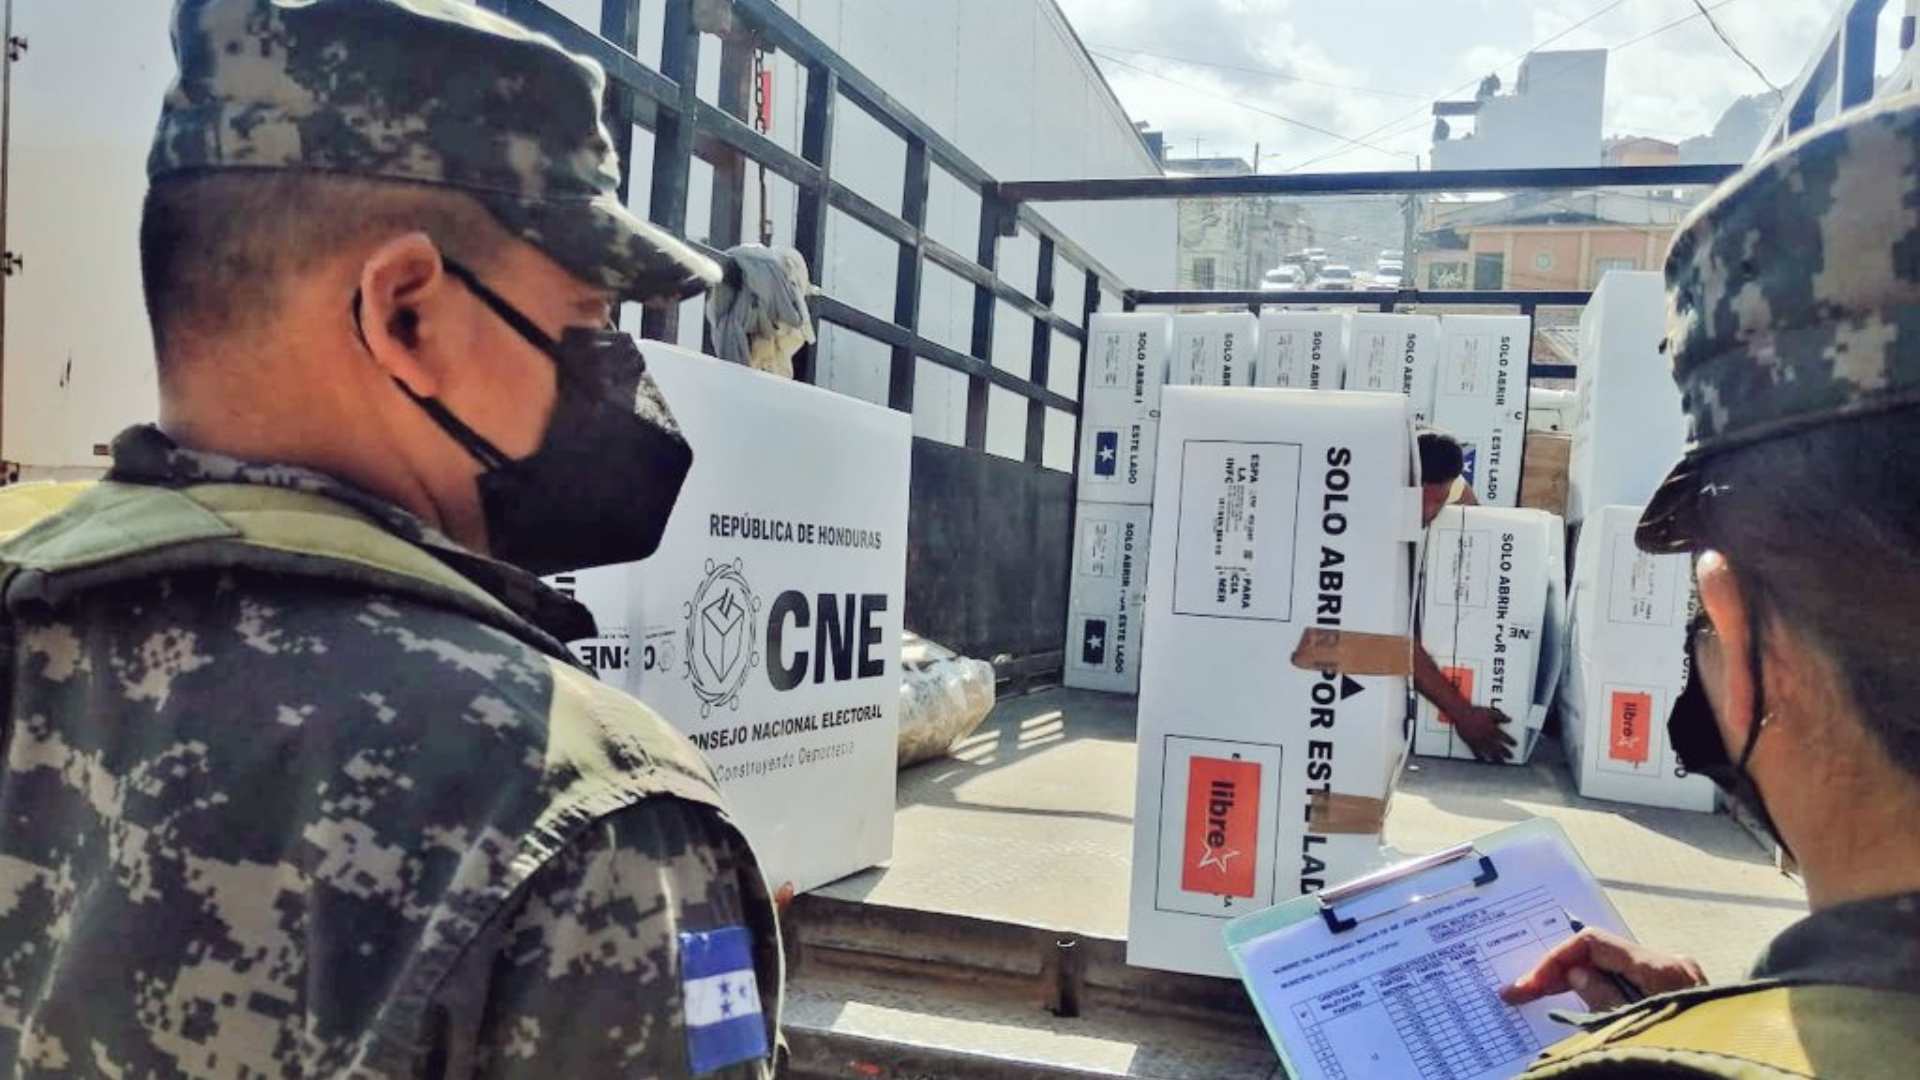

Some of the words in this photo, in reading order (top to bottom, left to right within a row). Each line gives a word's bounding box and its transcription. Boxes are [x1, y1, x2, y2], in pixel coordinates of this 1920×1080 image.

[1137, 331, 1147, 361] SOLO
[1223, 332, 1233, 362] SOLO
[1312, 331, 1322, 361] SOLO
[1405, 333, 1416, 364] SOLO
[1499, 336, 1510, 366] SOLO
[1309, 364, 1320, 390] ABRI
[1130, 424, 1140, 452] ESTE
[1490, 436, 1502, 465] ESTE
[1128, 454, 1138, 485] LADO
[1250, 453, 1260, 484] ESPA
[1322, 446, 1351, 536] SOLO
[1487, 469, 1499, 500] LADO
[709, 512, 794, 543] REPÚBLICA
[797, 523, 815, 545] DE
[817, 526, 882, 550] HONDURAS
[1124, 521, 1134, 551] SOLO
[1499, 532, 1514, 572] SOLO
[766, 589, 888, 692] CNE
[1114, 645, 1125, 674] LADO
[1491, 657, 1505, 693] ESTE
[688, 725, 748, 750] ONSEJO
[751, 715, 819, 742] NACIONAL
[821, 704, 883, 729] ELECTORAL
[1623, 702, 1637, 737] libre
[715, 752, 795, 783] Construyendo
[1207, 780, 1236, 848] libre
[1300, 834, 1328, 895] LAD
